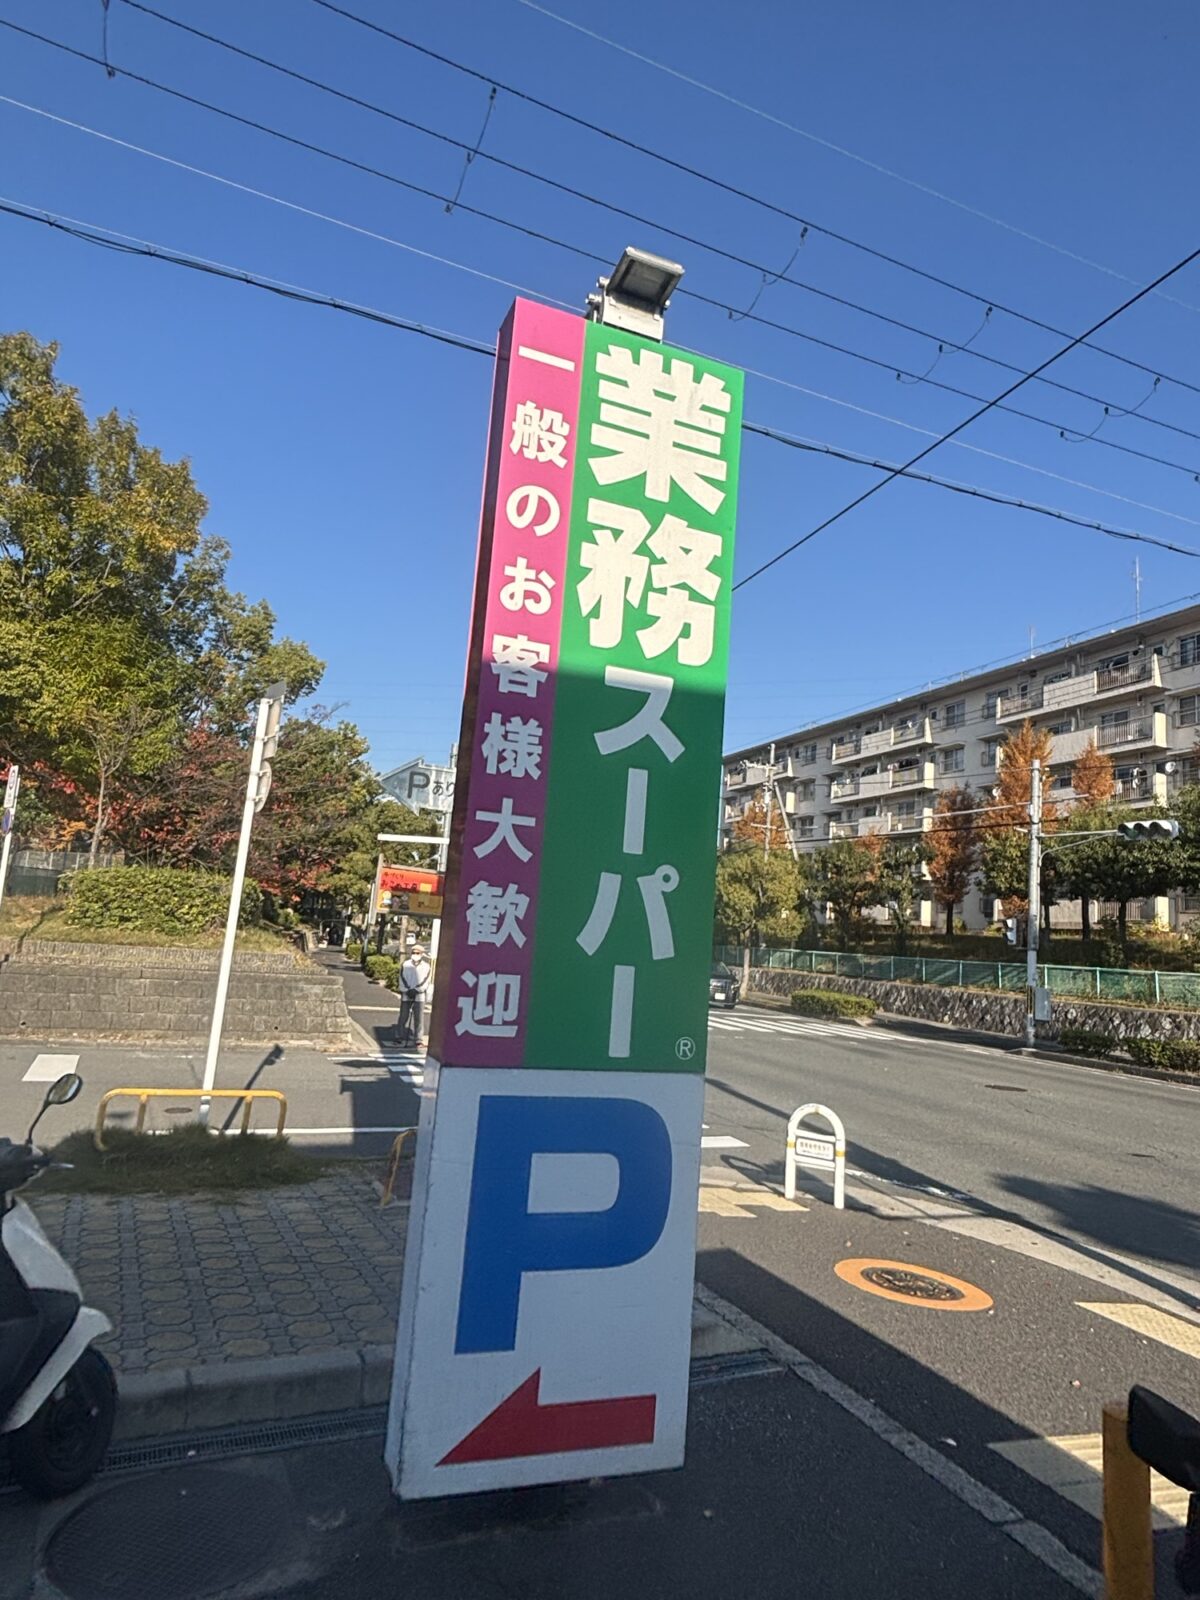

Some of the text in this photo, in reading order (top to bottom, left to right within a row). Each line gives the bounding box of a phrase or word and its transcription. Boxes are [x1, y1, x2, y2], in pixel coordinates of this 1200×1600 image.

[455, 344, 575, 1039] 一般のお客様大歓迎
[575, 343, 732, 1059] 業務スーパー
[454, 1094, 673, 1355] P
